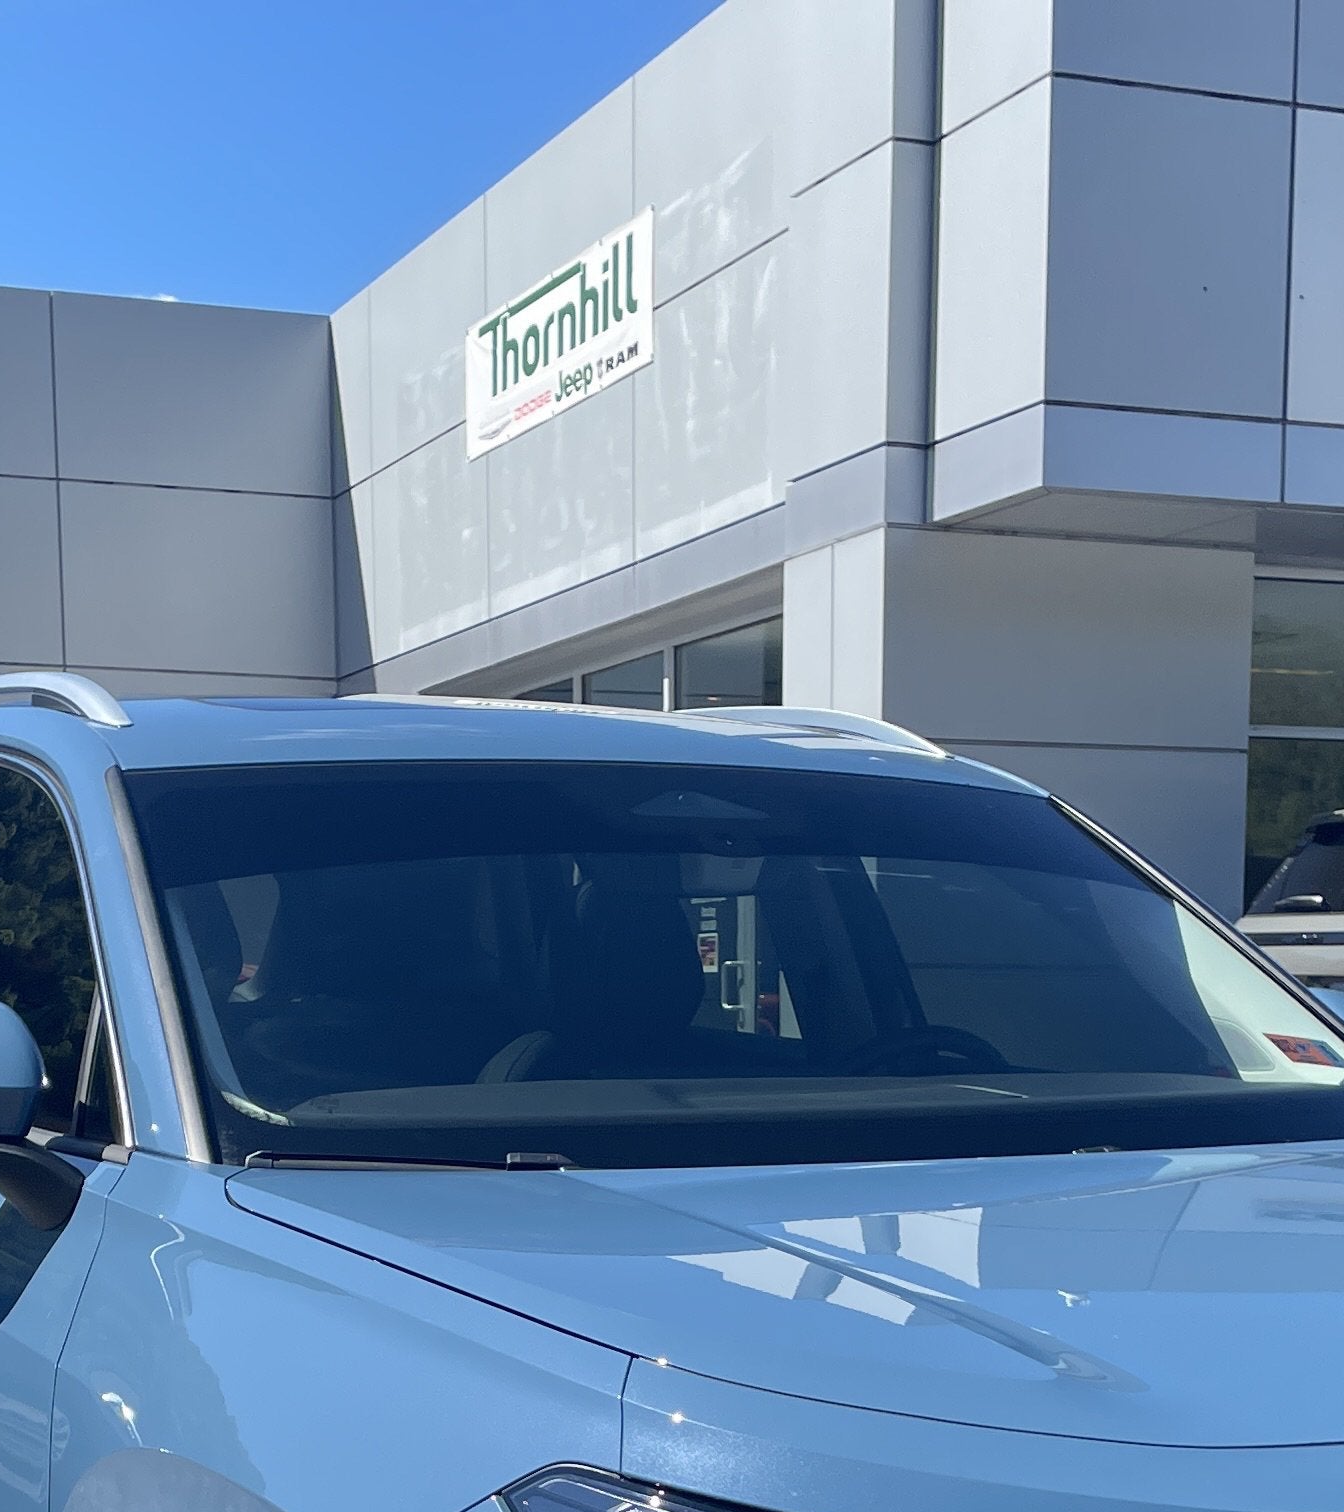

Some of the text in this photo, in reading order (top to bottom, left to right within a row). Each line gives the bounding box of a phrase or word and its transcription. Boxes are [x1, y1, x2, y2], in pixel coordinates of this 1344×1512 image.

[478, 231, 639, 398] Thornhill
[554, 362, 594, 403] Jeep
[605, 341, 640, 374] RAM
